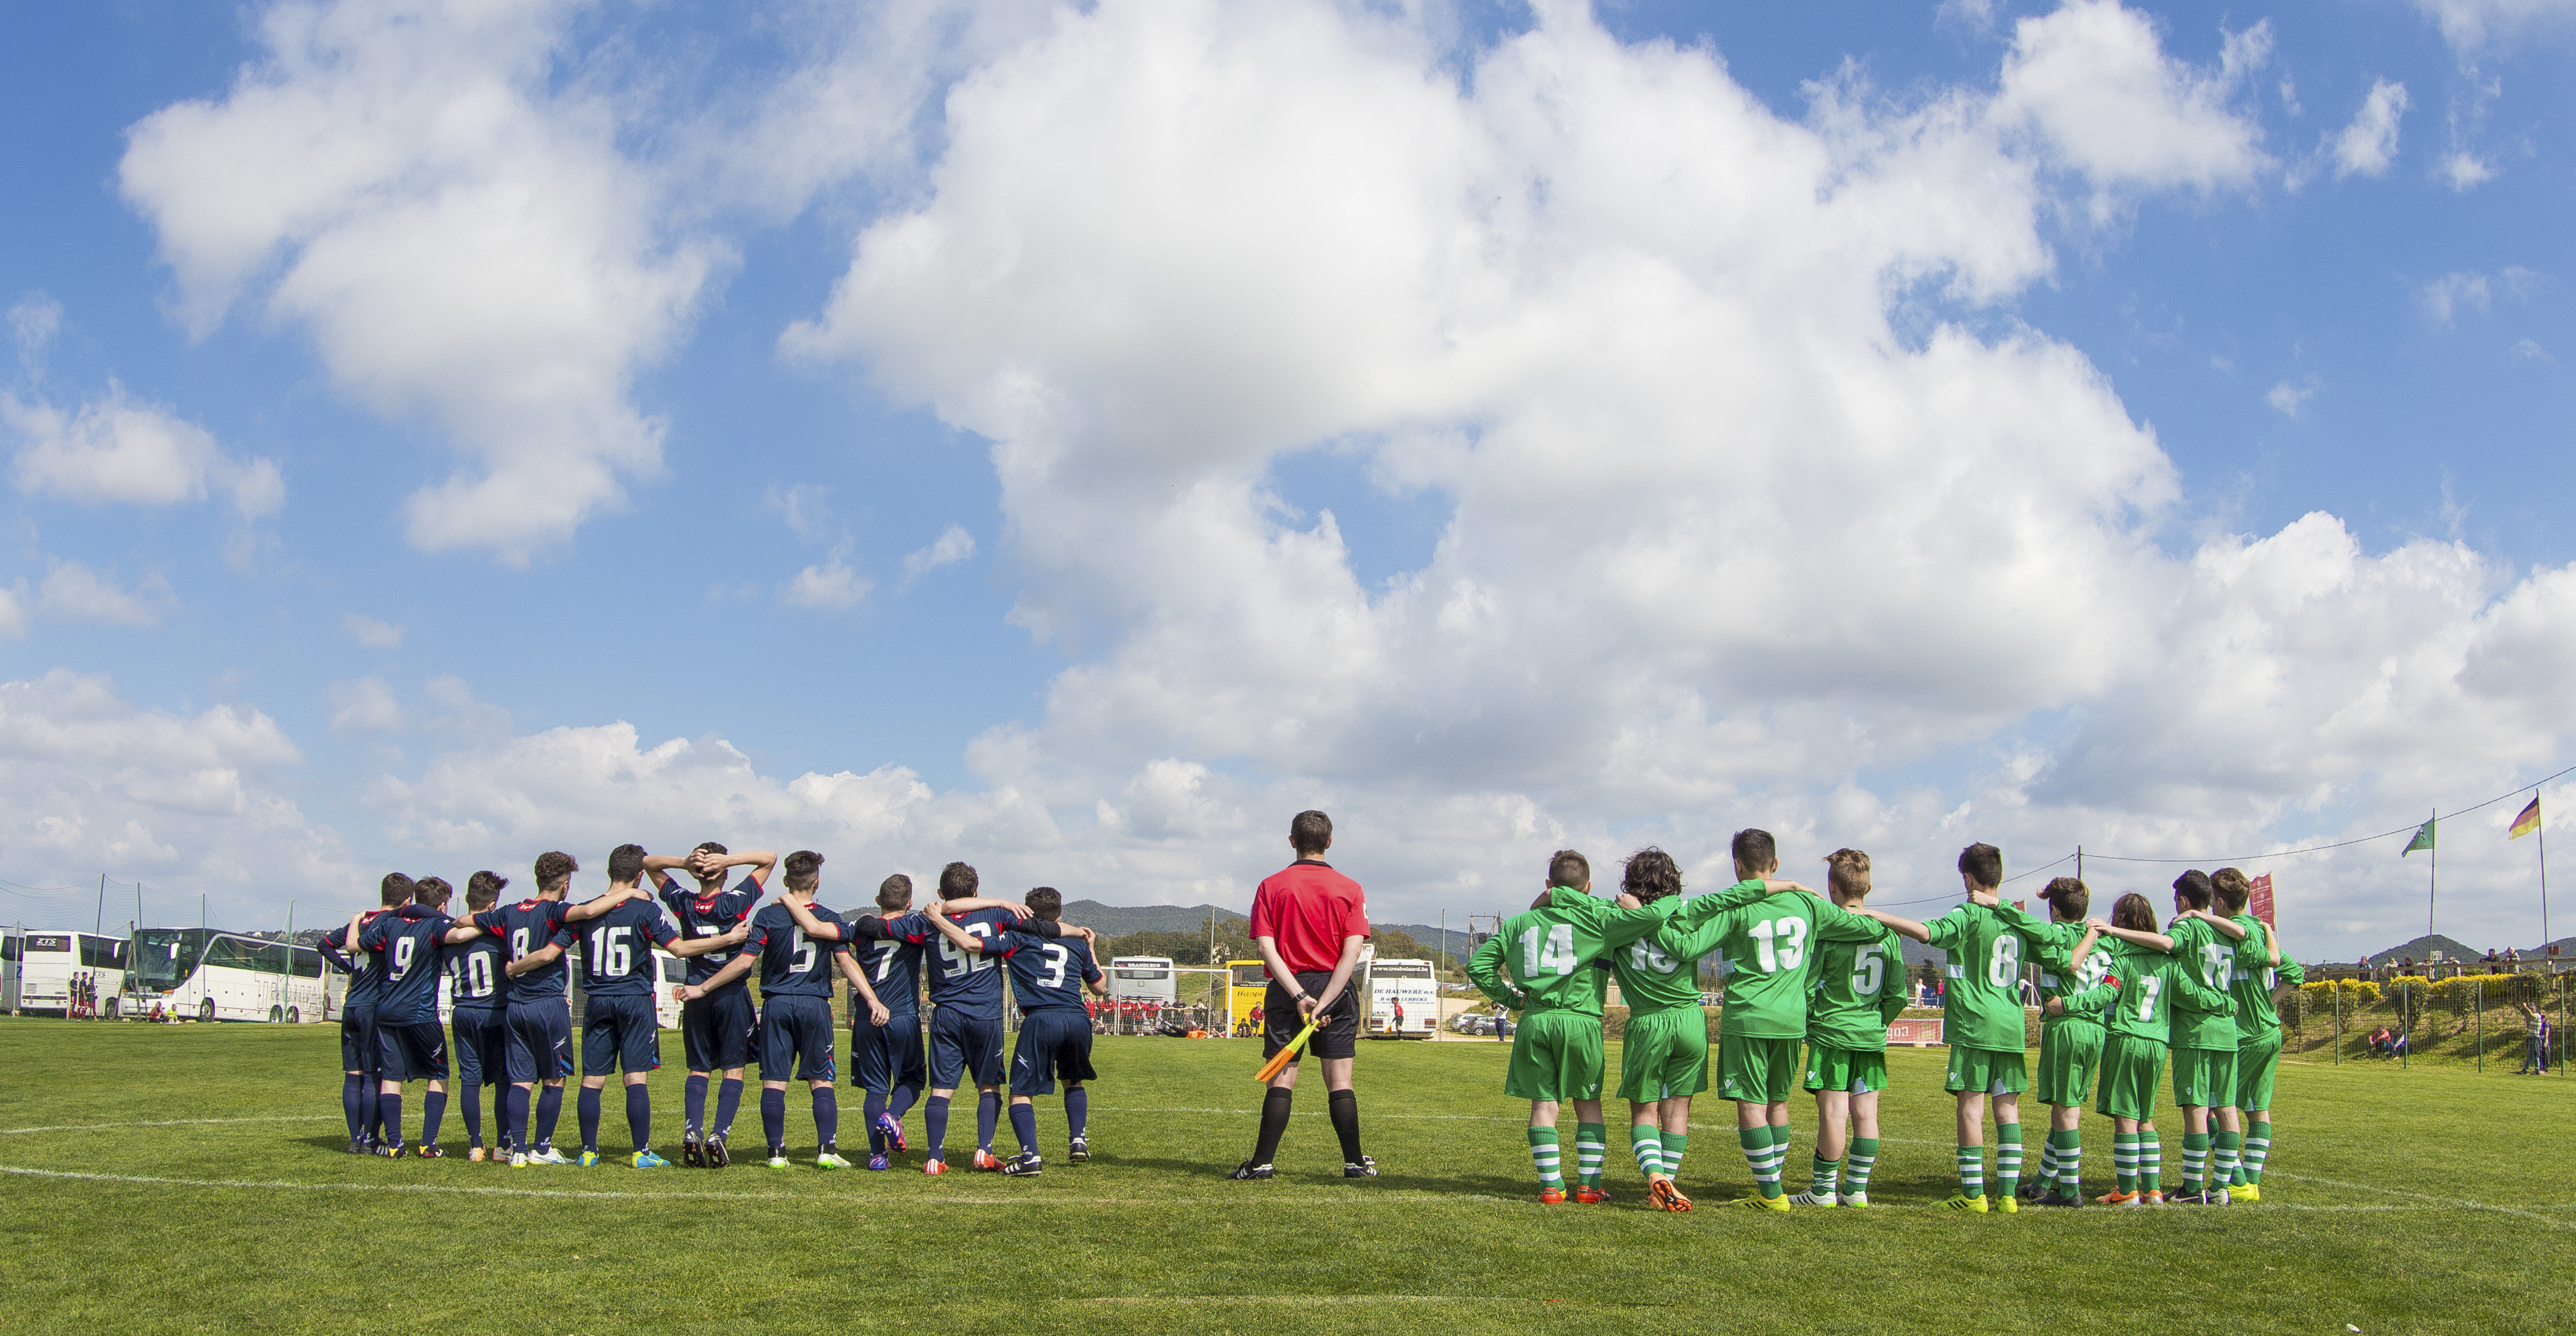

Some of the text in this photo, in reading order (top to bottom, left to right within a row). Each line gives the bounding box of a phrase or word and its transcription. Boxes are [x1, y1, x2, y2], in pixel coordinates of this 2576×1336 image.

[390, 936, 415, 981] 9
[512, 927, 529, 977] 8
[591, 927, 631, 977] 16
[789, 925, 817, 973] 5
[874, 940, 901, 983] 7
[939, 922, 995, 978] 92
[1037, 943, 1068, 988] 3
[1519, 924, 1577, 977] 14
[1748, 917, 1808, 973] 13
[1852, 943, 1883, 995] 5
[1989, 935, 2018, 987] 8
[2198, 942, 2233, 991] 15
[450, 951, 493, 997] 10
[2140, 975, 2161, 1023] 7
